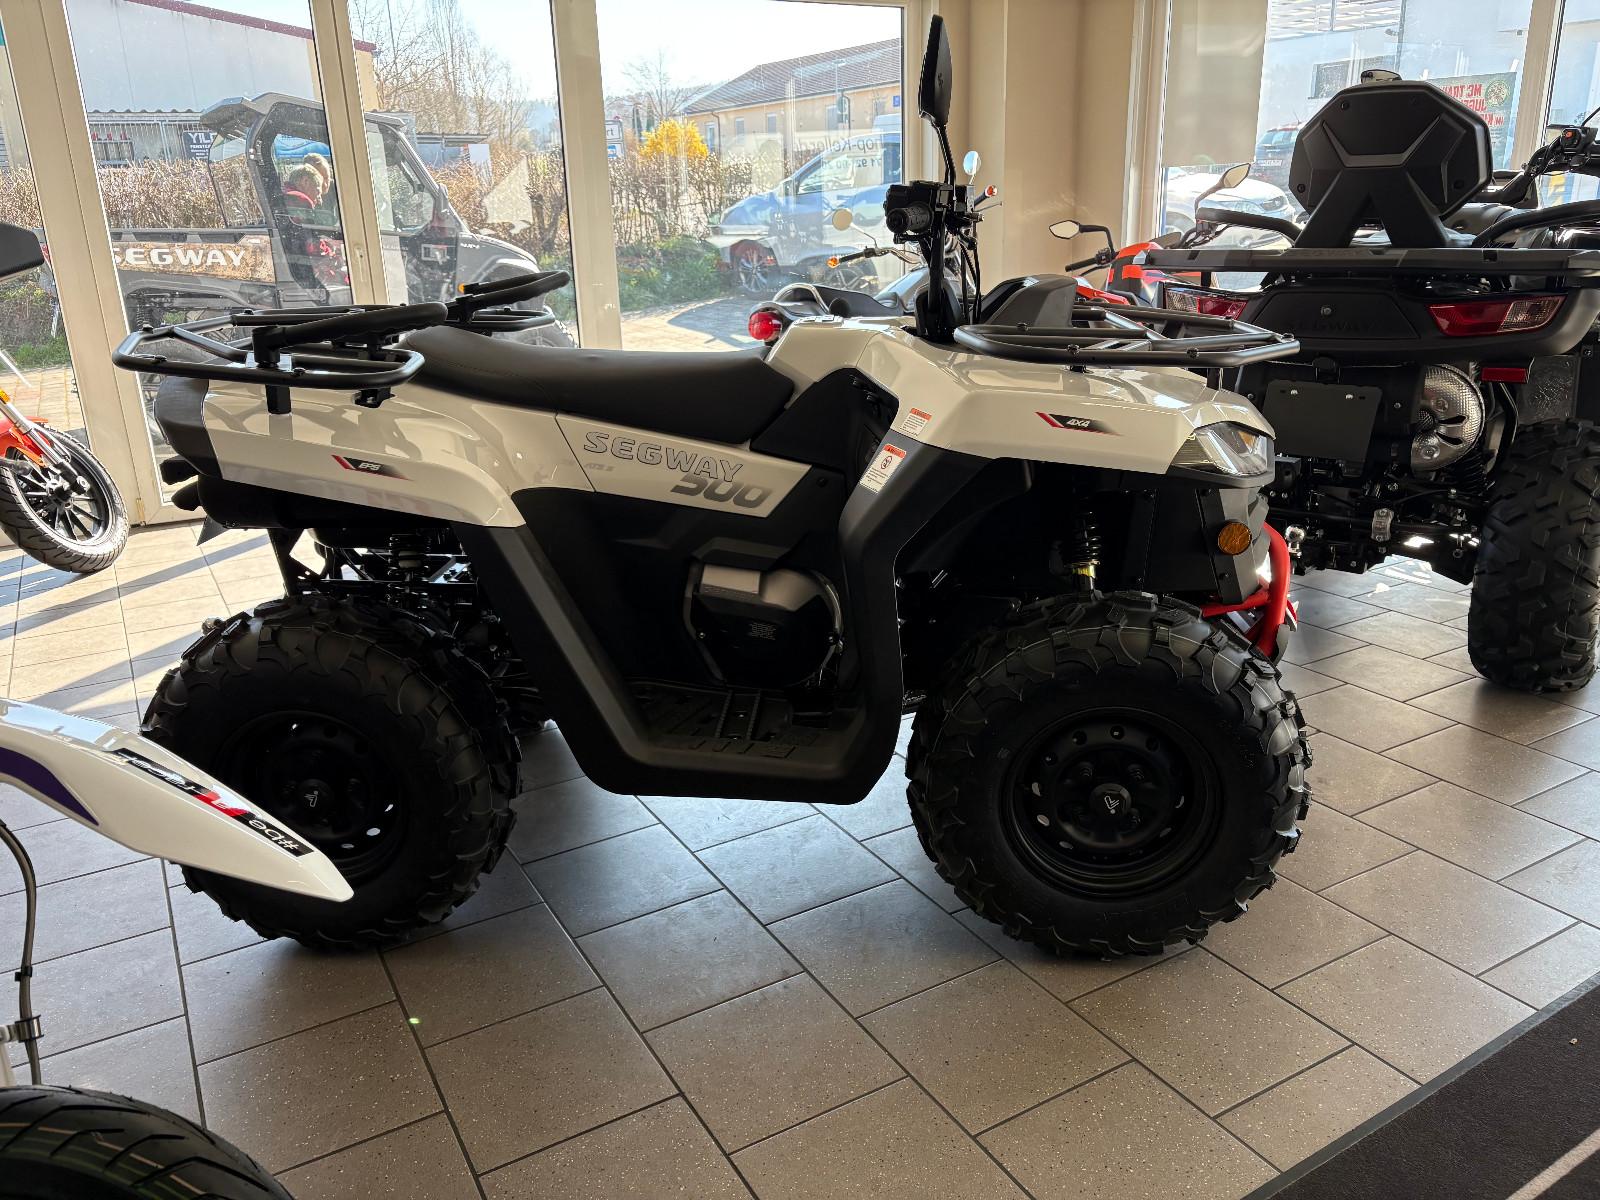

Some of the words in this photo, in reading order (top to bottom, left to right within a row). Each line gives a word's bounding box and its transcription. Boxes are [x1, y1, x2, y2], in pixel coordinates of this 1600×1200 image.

[358, 462, 381, 471] EPS
[583, 431, 743, 482] SEGWAY
[248, 819, 300, 851] #be
